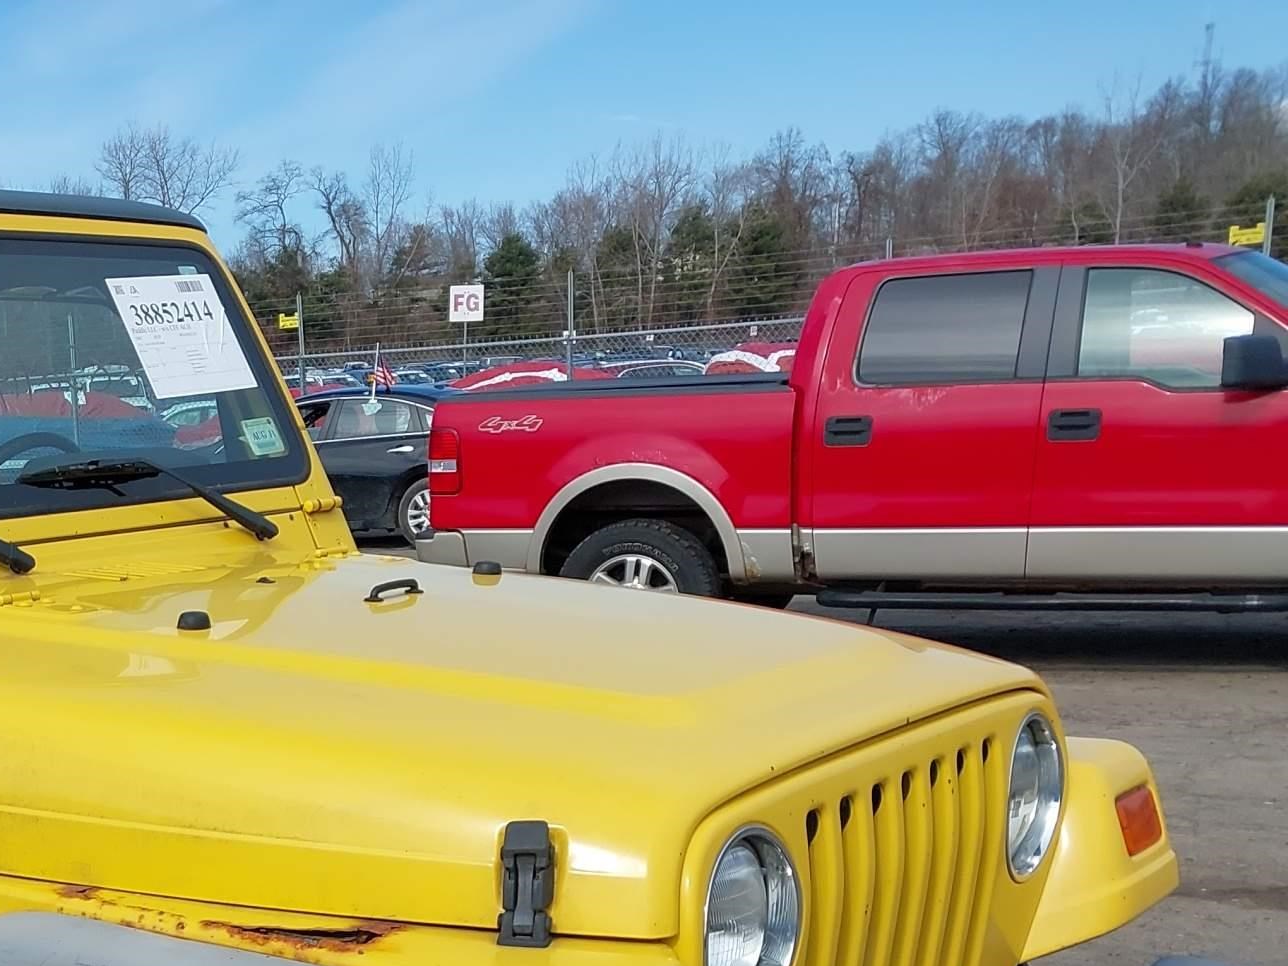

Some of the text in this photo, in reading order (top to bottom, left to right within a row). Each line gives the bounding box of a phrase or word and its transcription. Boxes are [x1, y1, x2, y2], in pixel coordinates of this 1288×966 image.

[129, 299, 214, 326] 38852414
[454, 293, 480, 312] FG
[478, 414, 544, 434] 4x4
